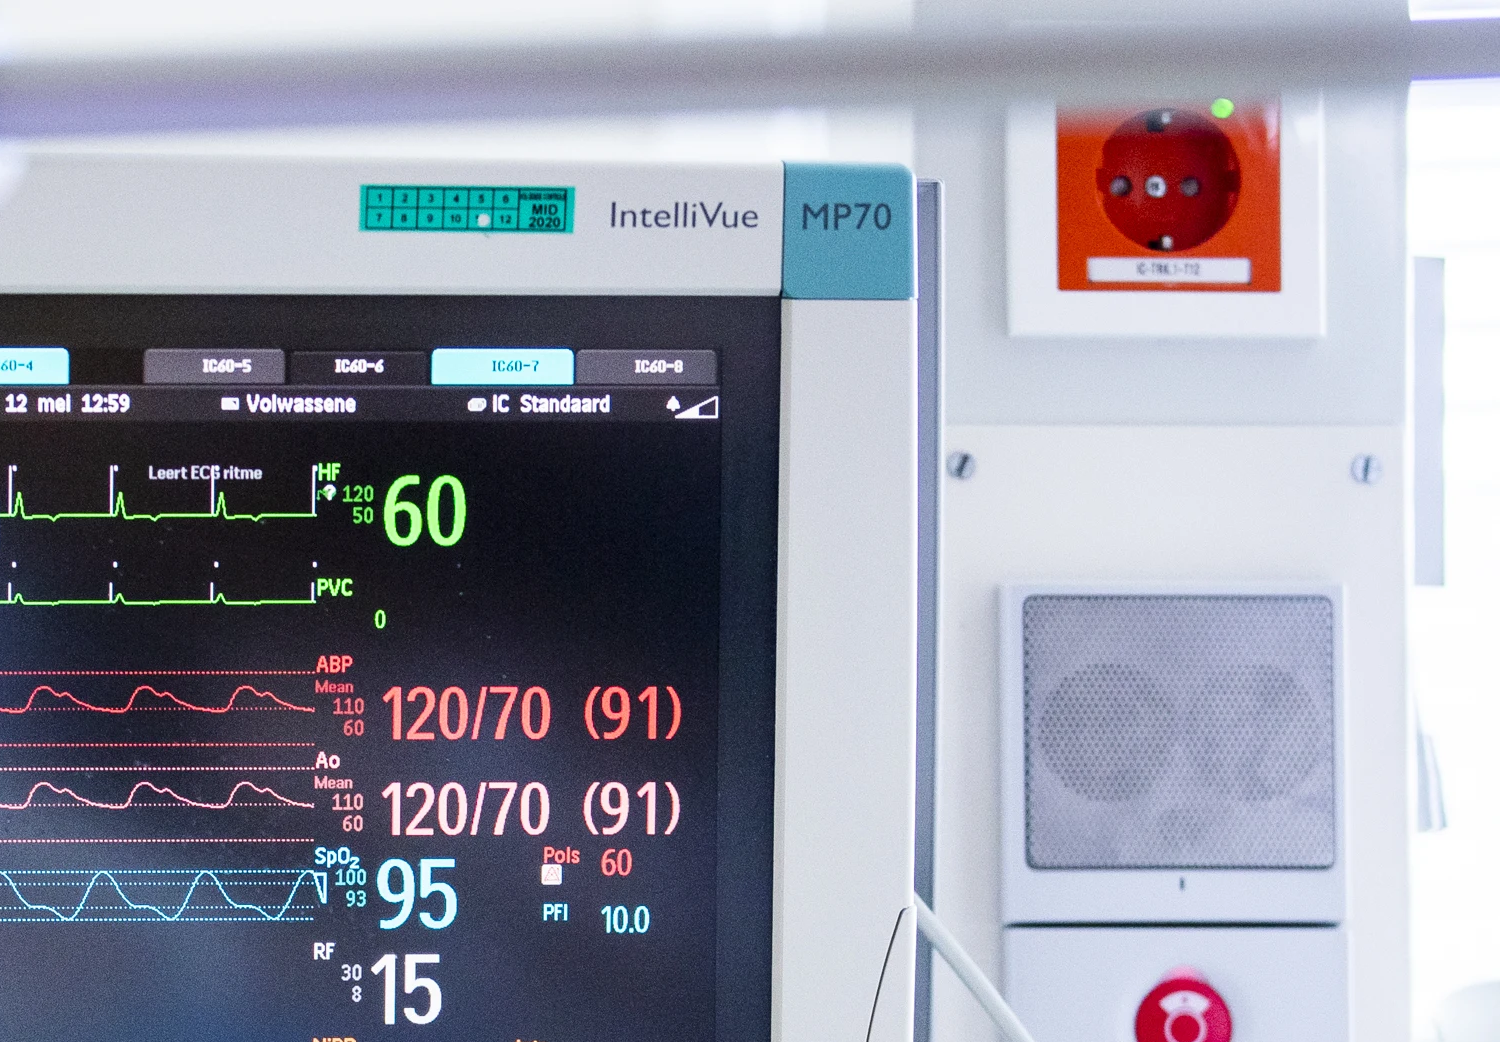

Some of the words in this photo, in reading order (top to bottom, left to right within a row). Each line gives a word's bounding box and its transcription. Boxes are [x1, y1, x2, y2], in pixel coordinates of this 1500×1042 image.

[377, 193, 383, 202] 1
[402, 193, 408, 202] 2
[428, 193, 434, 202] 3
[453, 194, 460, 203] 4
[478, 194, 484, 204] 5
[502, 195, 509, 204] 6
[376, 213, 382, 222] 7
[401, 213, 407, 222] 8
[427, 213, 434, 223] 9
[450, 214, 462, 223] 10
[501, 214, 512, 224] 12
[532, 203, 558, 216] MID
[610, 201, 759, 229] IntelliVue
[802, 202, 892, 231] MP70
[528, 216, 560, 228] 2020
[202, 358, 252, 374] IC60-5
[334, 358, 384, 374] IC60-6
[492, 360, 539, 372] IC60-7
[635, 358, 684, 374] IC60-8
[4, 395, 28, 413] 12
[38, 394, 72, 413] mei
[81, 394, 130, 414] 12:59
[247, 395, 356, 414] Volwassene
[492, 395, 510, 414] IC
[520, 394, 610, 414] Standaard
[148, 466, 187, 480] Leert
[222, 466, 262, 480] ritme
[317, 462, 341, 482] HF
[342, 486, 374, 502] 120
[353, 508, 374, 524] 50
[383, 474, 467, 547] 60
[316, 579, 354, 597] PVC
[374, 610, 387, 629] 0
[316, 656, 353, 674] ABP
[314, 680, 354, 694] Mean
[332, 698, 364, 715] 110
[382, 685, 552, 740] 120/70
[583, 685, 682, 741] (91)
[344, 720, 364, 736] 60
[314, 752, 341, 770] Ao
[314, 776, 353, 790] Mean
[332, 794, 364, 810] 110
[381, 781, 550, 836] 120/70
[582, 780, 681, 836] (91)
[342, 816, 364, 832] 60
[543, 846, 580, 864] Pols
[601, 848, 632, 876] 60
[334, 869, 367, 886] 100
[346, 890, 367, 908] 93
[376, 857, 458, 930] 95
[542, 903, 568, 922] PFI
[601, 905, 650, 934] 10.0
[313, 942, 336, 960] RF
[341, 964, 362, 980] 30
[352, 986, 362, 1002] 8
[370, 953, 442, 1026] 15
